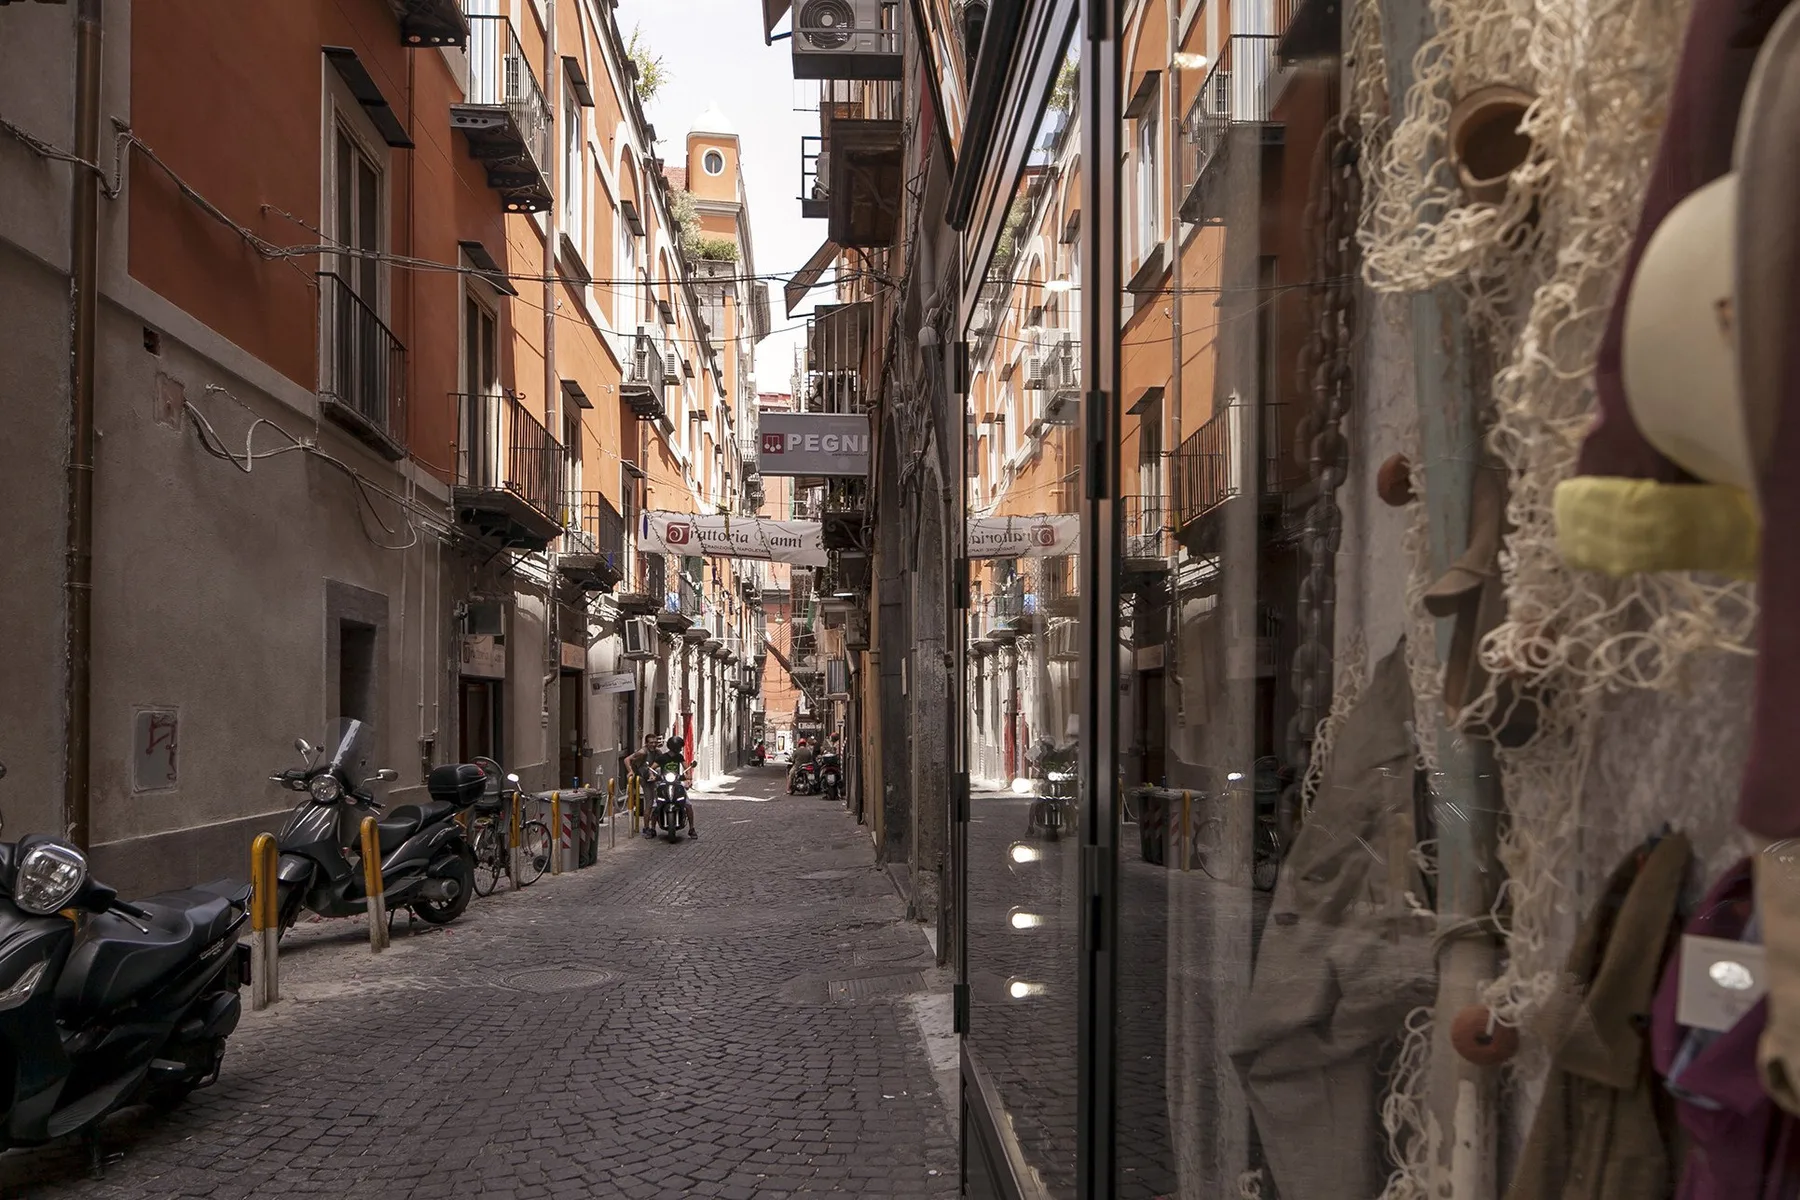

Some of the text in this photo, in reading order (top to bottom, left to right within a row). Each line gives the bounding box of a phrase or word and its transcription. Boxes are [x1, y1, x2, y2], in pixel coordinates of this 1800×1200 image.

[787, 433, 868, 453] PEGNI
[668, 524, 803, 551] Trattoria Nanni
